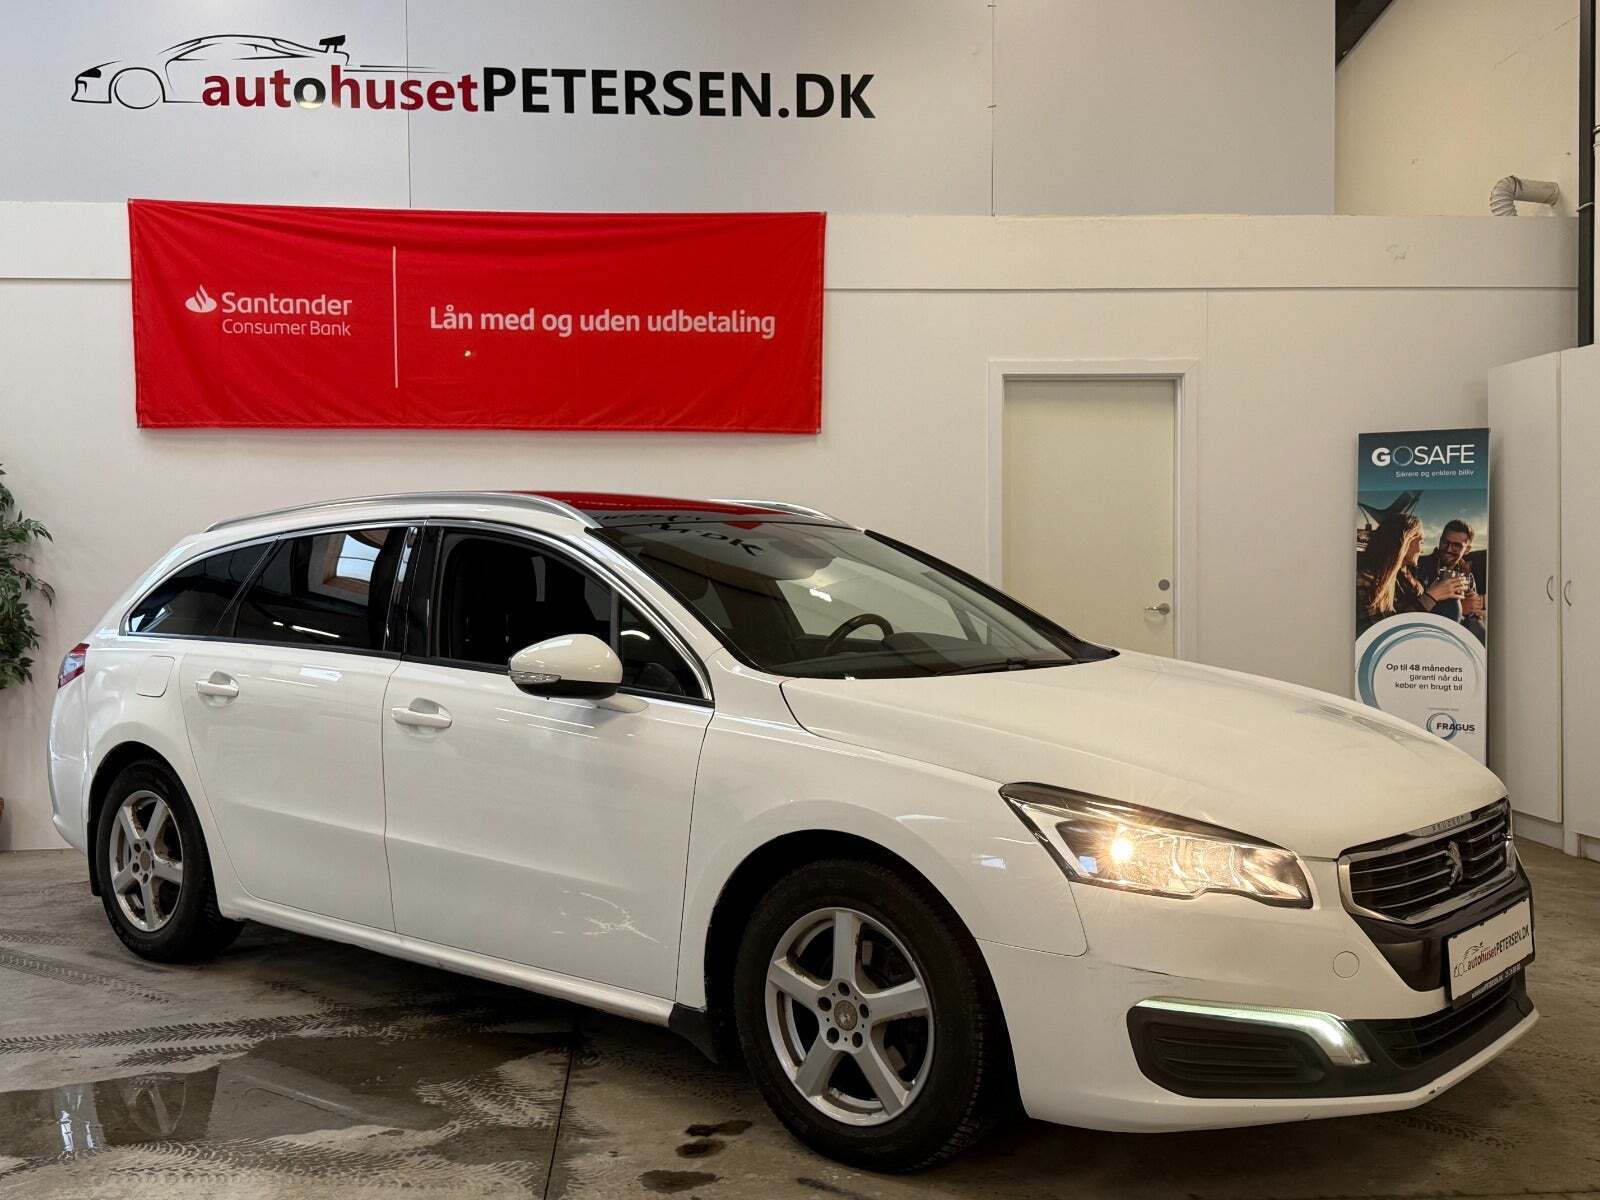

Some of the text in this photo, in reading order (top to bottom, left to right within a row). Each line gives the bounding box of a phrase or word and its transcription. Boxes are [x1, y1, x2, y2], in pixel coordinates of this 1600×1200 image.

[201, 65, 877, 119] autohusetPETERSEN.DK
[221, 291, 353, 316] Santander
[221, 318, 352, 336] Consumer Bank
[430, 304, 776, 339] Lån med og uden udbetaling
[1371, 443, 1475, 468] GOSAFE
[1386, 663, 1398, 672] Op
[1400, 663, 1408, 671] til
[1422, 663, 1463, 673] måneders
[1395, 681, 1416, 689] køber
[1431, 683, 1451, 692] brugt
[1453, 683, 1463, 691] bil
[1410, 674, 1436, 682] garanti
[1438, 674, 1450, 682] når
[1436, 722, 1476, 732] FRAGUS
